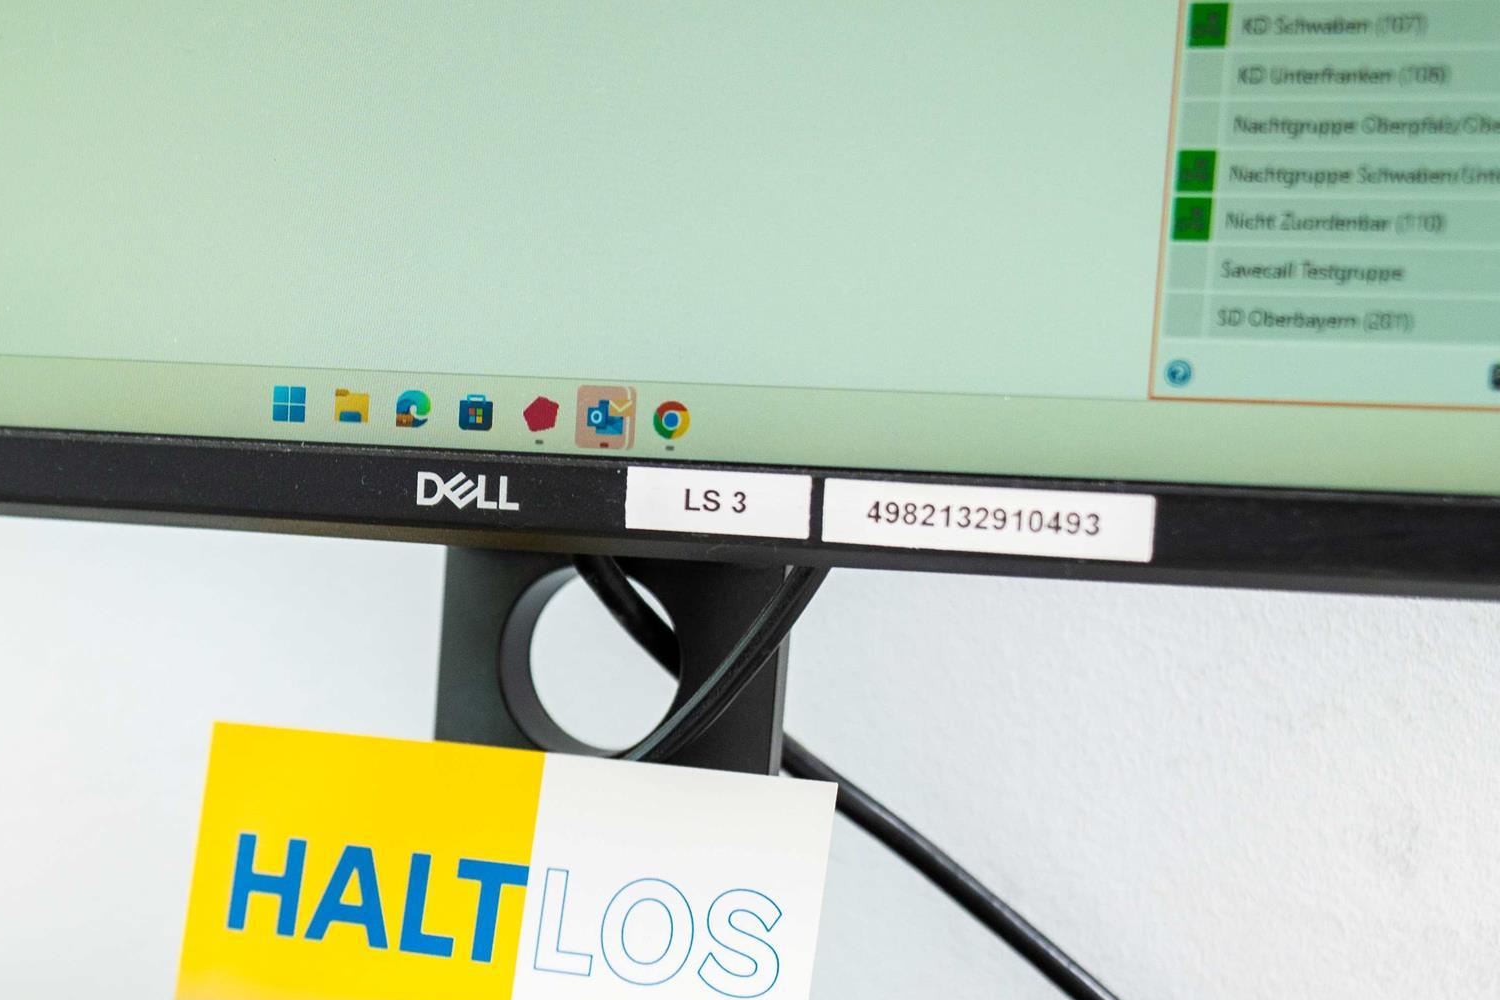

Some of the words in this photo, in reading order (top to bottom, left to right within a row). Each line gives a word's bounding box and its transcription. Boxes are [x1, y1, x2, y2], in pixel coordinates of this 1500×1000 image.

[1275, 14, 1368, 36] Schwaben
[1270, 66, 1392, 86] Unterfranken
[1232, 116, 1355, 139] Nachtgruppe
[1229, 165, 1350, 188] Nachtgruppe
[1225, 211, 1275, 231] Nicht
[1280, 211, 1388, 232] Zuordenbar
[1220, 260, 1295, 280] Savecall
[1300, 260, 1405, 284] Testgruppe
[1249, 310, 1357, 332] Oberbayern
[416, 471, 519, 510] DELL
[683, 488, 723, 513] LS
[731, 490, 748, 515] 3
[866, 499, 1102, 537] 4982132910493
